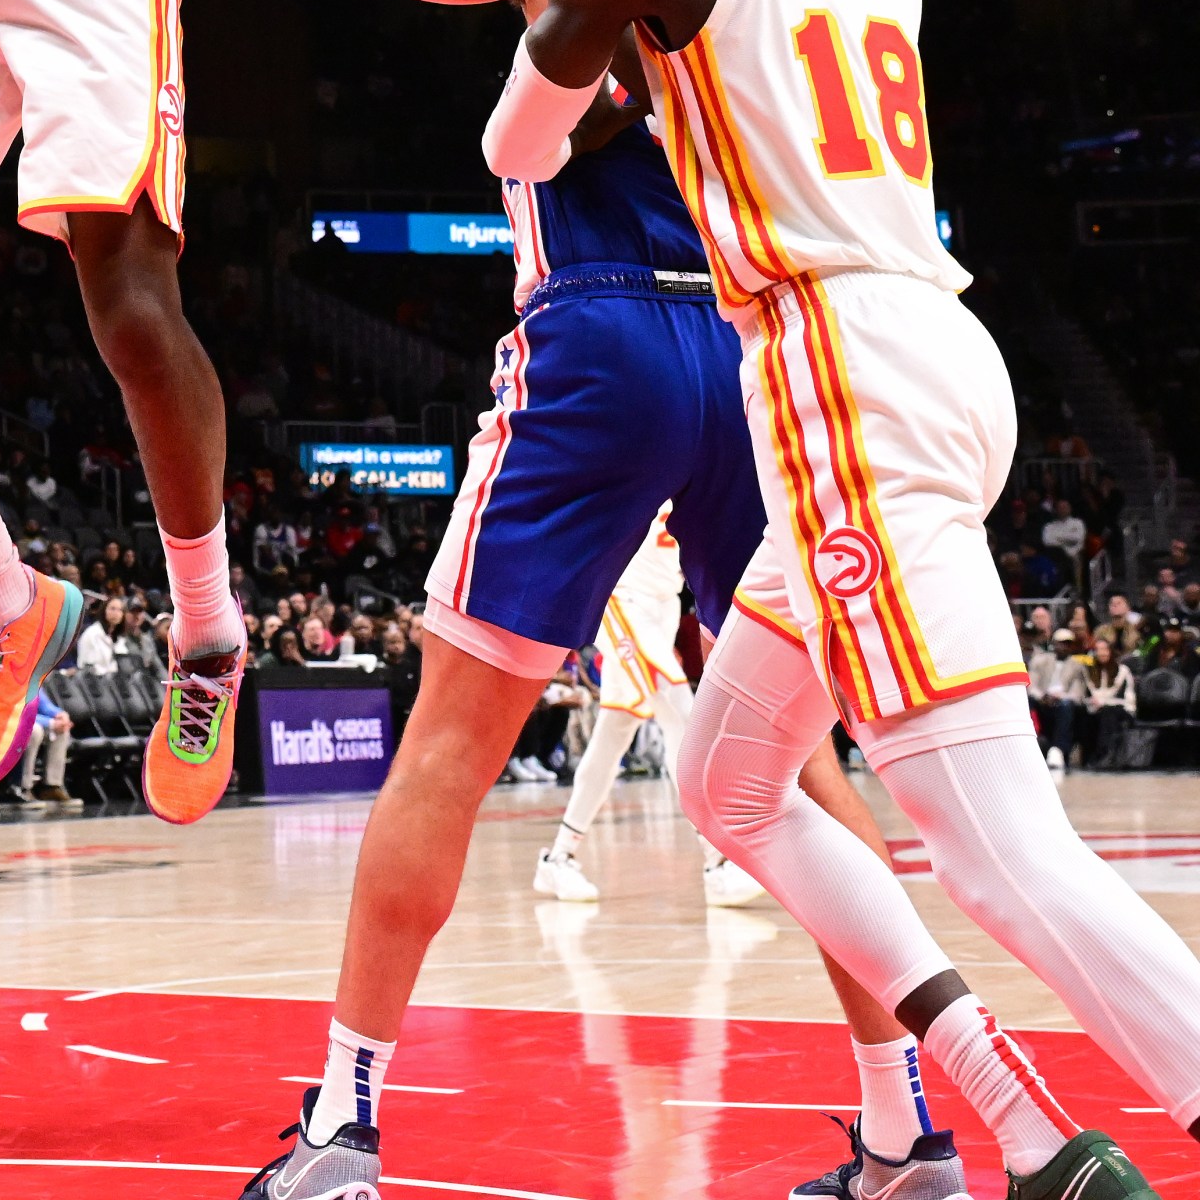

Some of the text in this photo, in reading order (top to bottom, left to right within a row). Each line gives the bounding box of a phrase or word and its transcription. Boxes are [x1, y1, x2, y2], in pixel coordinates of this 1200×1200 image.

[790, 8, 933, 189] 18
[313, 447, 442, 465] Injured in a wreck?
[335, 740, 384, 761] CASINOS
